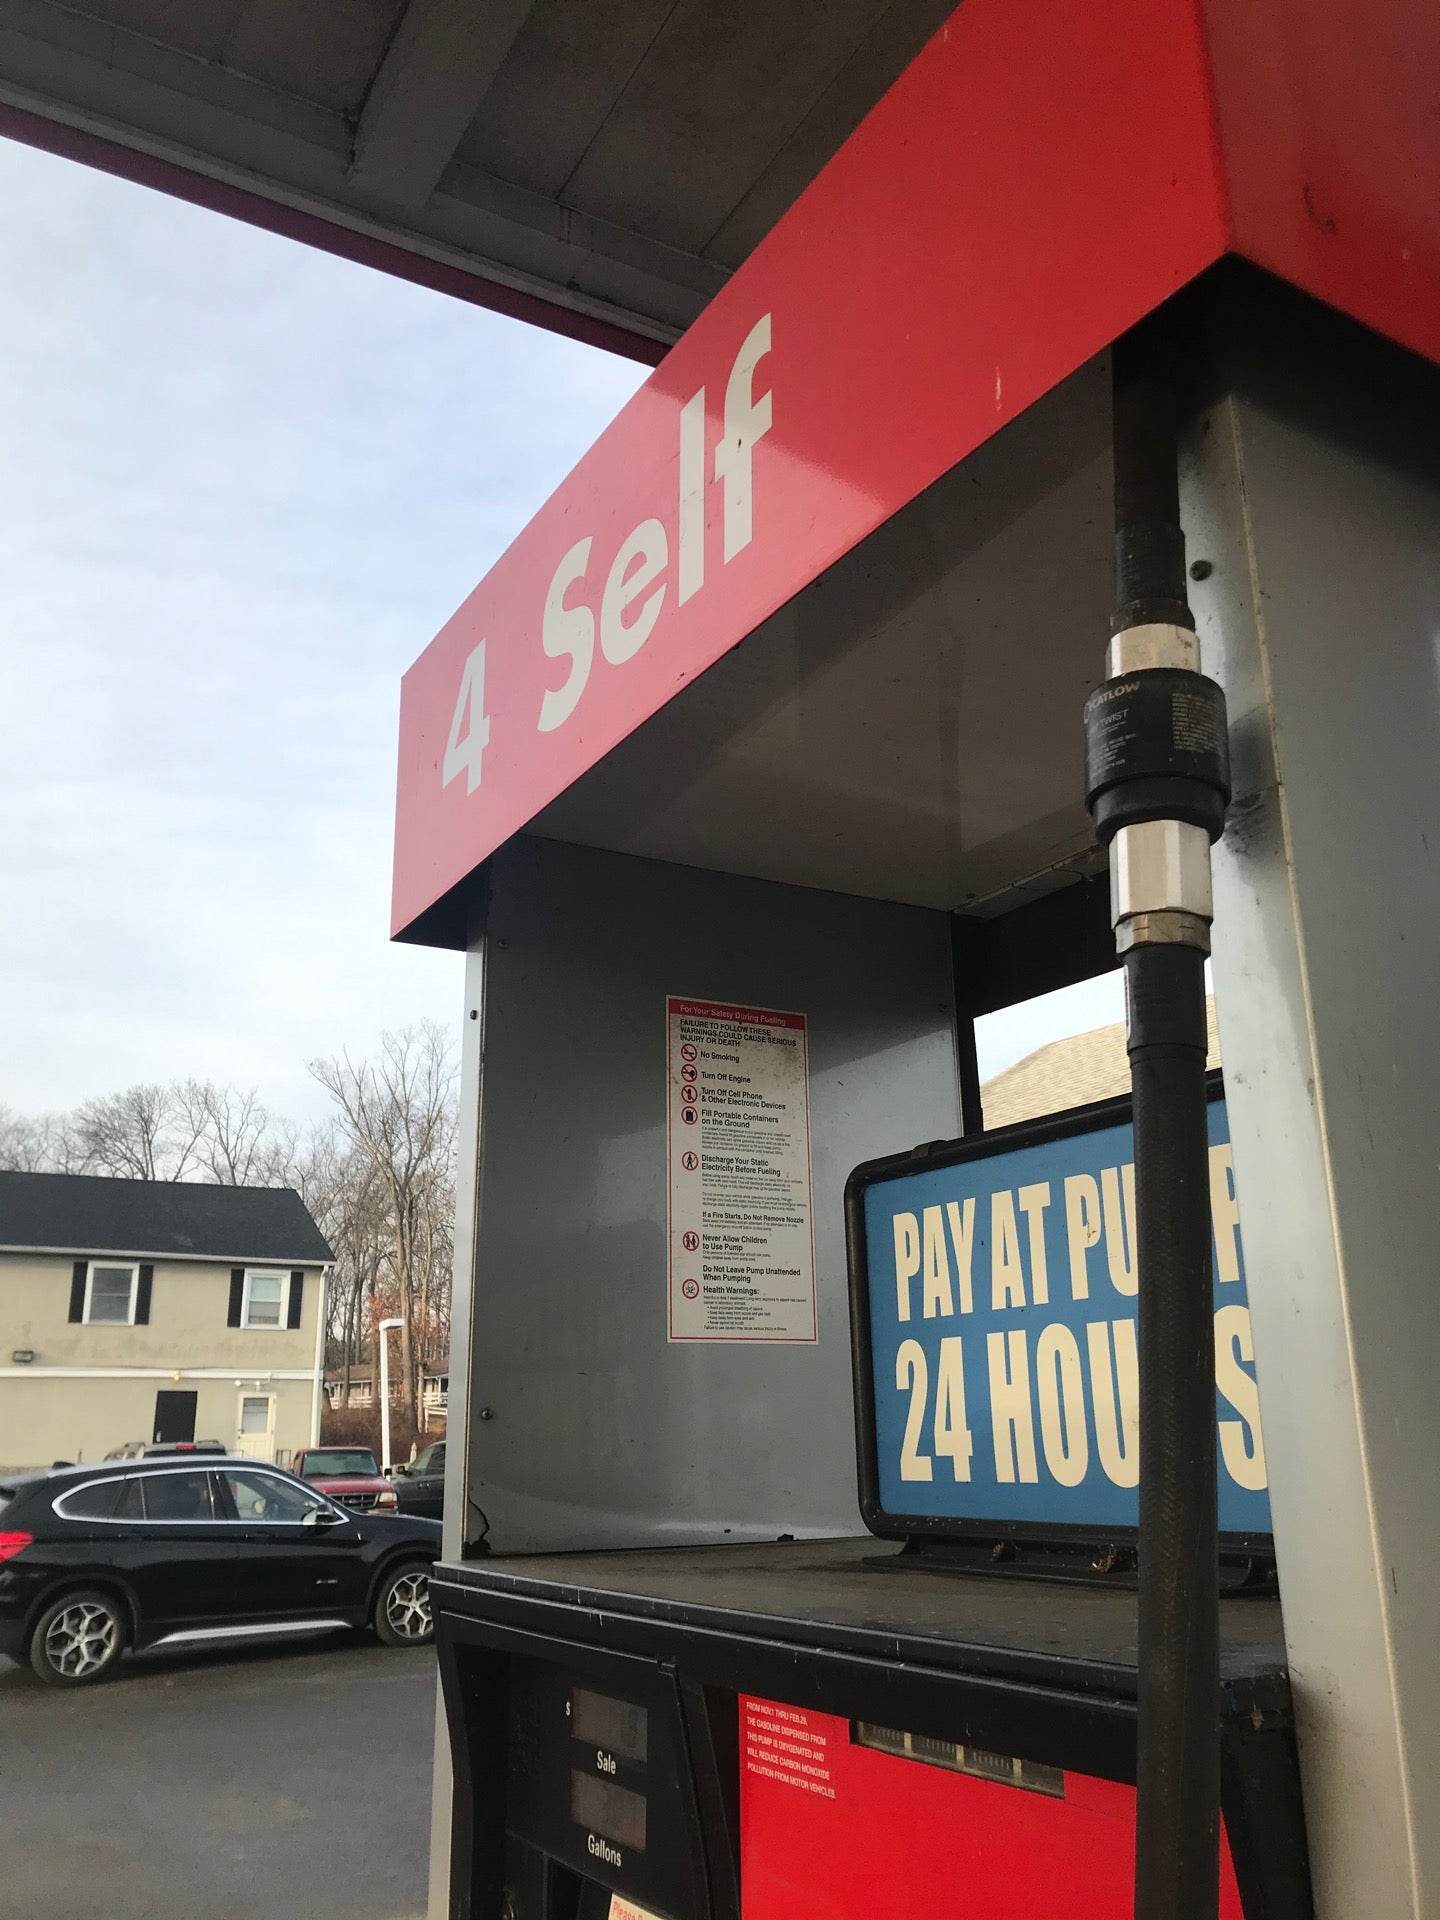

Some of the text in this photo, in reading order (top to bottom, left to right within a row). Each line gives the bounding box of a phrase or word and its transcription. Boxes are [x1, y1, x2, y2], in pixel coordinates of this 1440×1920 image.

[442, 312, 773, 796] 4 Self
[680, 1004, 786, 1026] For Your Safety During Fueling
[680, 1018, 771, 1036] FAILURE TO FOLLOW THESE
[680, 1027, 797, 1047] WARNINGS COULD CAUSE SERIOUS
[680, 1034, 740, 1047] INJURY OR DEATH
[701, 1050, 740, 1063] No Smoking
[701, 1071, 751, 1084] Turn Off Engine
[701, 1087, 763, 1100] Turn Off Cell Phone
[706, 1096, 726, 1104] Other
[728, 1098, 760, 1107] Electronic
[761, 1101, 786, 1110] Devices
[701, 1109, 779, 1123] Fill Portable Containers
[712, 1118, 723, 1126] the
[725, 1119, 750, 1128] Ground
[701, 1155, 769, 1167] Discharge Your Static
[701, 1163, 781, 1177] Electricity Before Fueling
[743, 1213, 751, 1221] Do
[763, 1215, 785, 1223] Remove
[786, 1216, 804, 1224] Nozzle
[702, 1233, 768, 1244] Never Allow Children
[893, 1143, 1240, 1322] PAY AT PUP
[711, 1243, 723, 1251] Use
[725, 1244, 743, 1252] Pump
[713, 1265, 725, 1273] Not
[726, 1266, 745, 1274] Leave
[746, 1267, 764, 1276] Pump
[765, 1268, 801, 1276] Unattended
[703, 1273, 751, 1284] When Pumping
[703, 1285, 760, 1296] Health Warnings:
[896, 1304, 1268, 1491] 24 HOUS
[746, 1701, 760, 1712] FROM
[775, 1708, 789, 1720] THRU
[747, 1716, 826, 1746] THE GASOLINE DISPENSED FROM
[747, 1731, 824, 1762] THIS PUMP IS OXYGENATED AND
[596, 1750, 617, 1775] Sale
[747, 1746, 830, 1780] WILL REDUCE CARBON MONOXIDE
[747, 1762, 774, 1778] POLLUTION
[774, 1771, 789, 1783] FROM
[789, 1775, 809, 1790] MOTOR
[587, 1833, 622, 1867] Gallons
